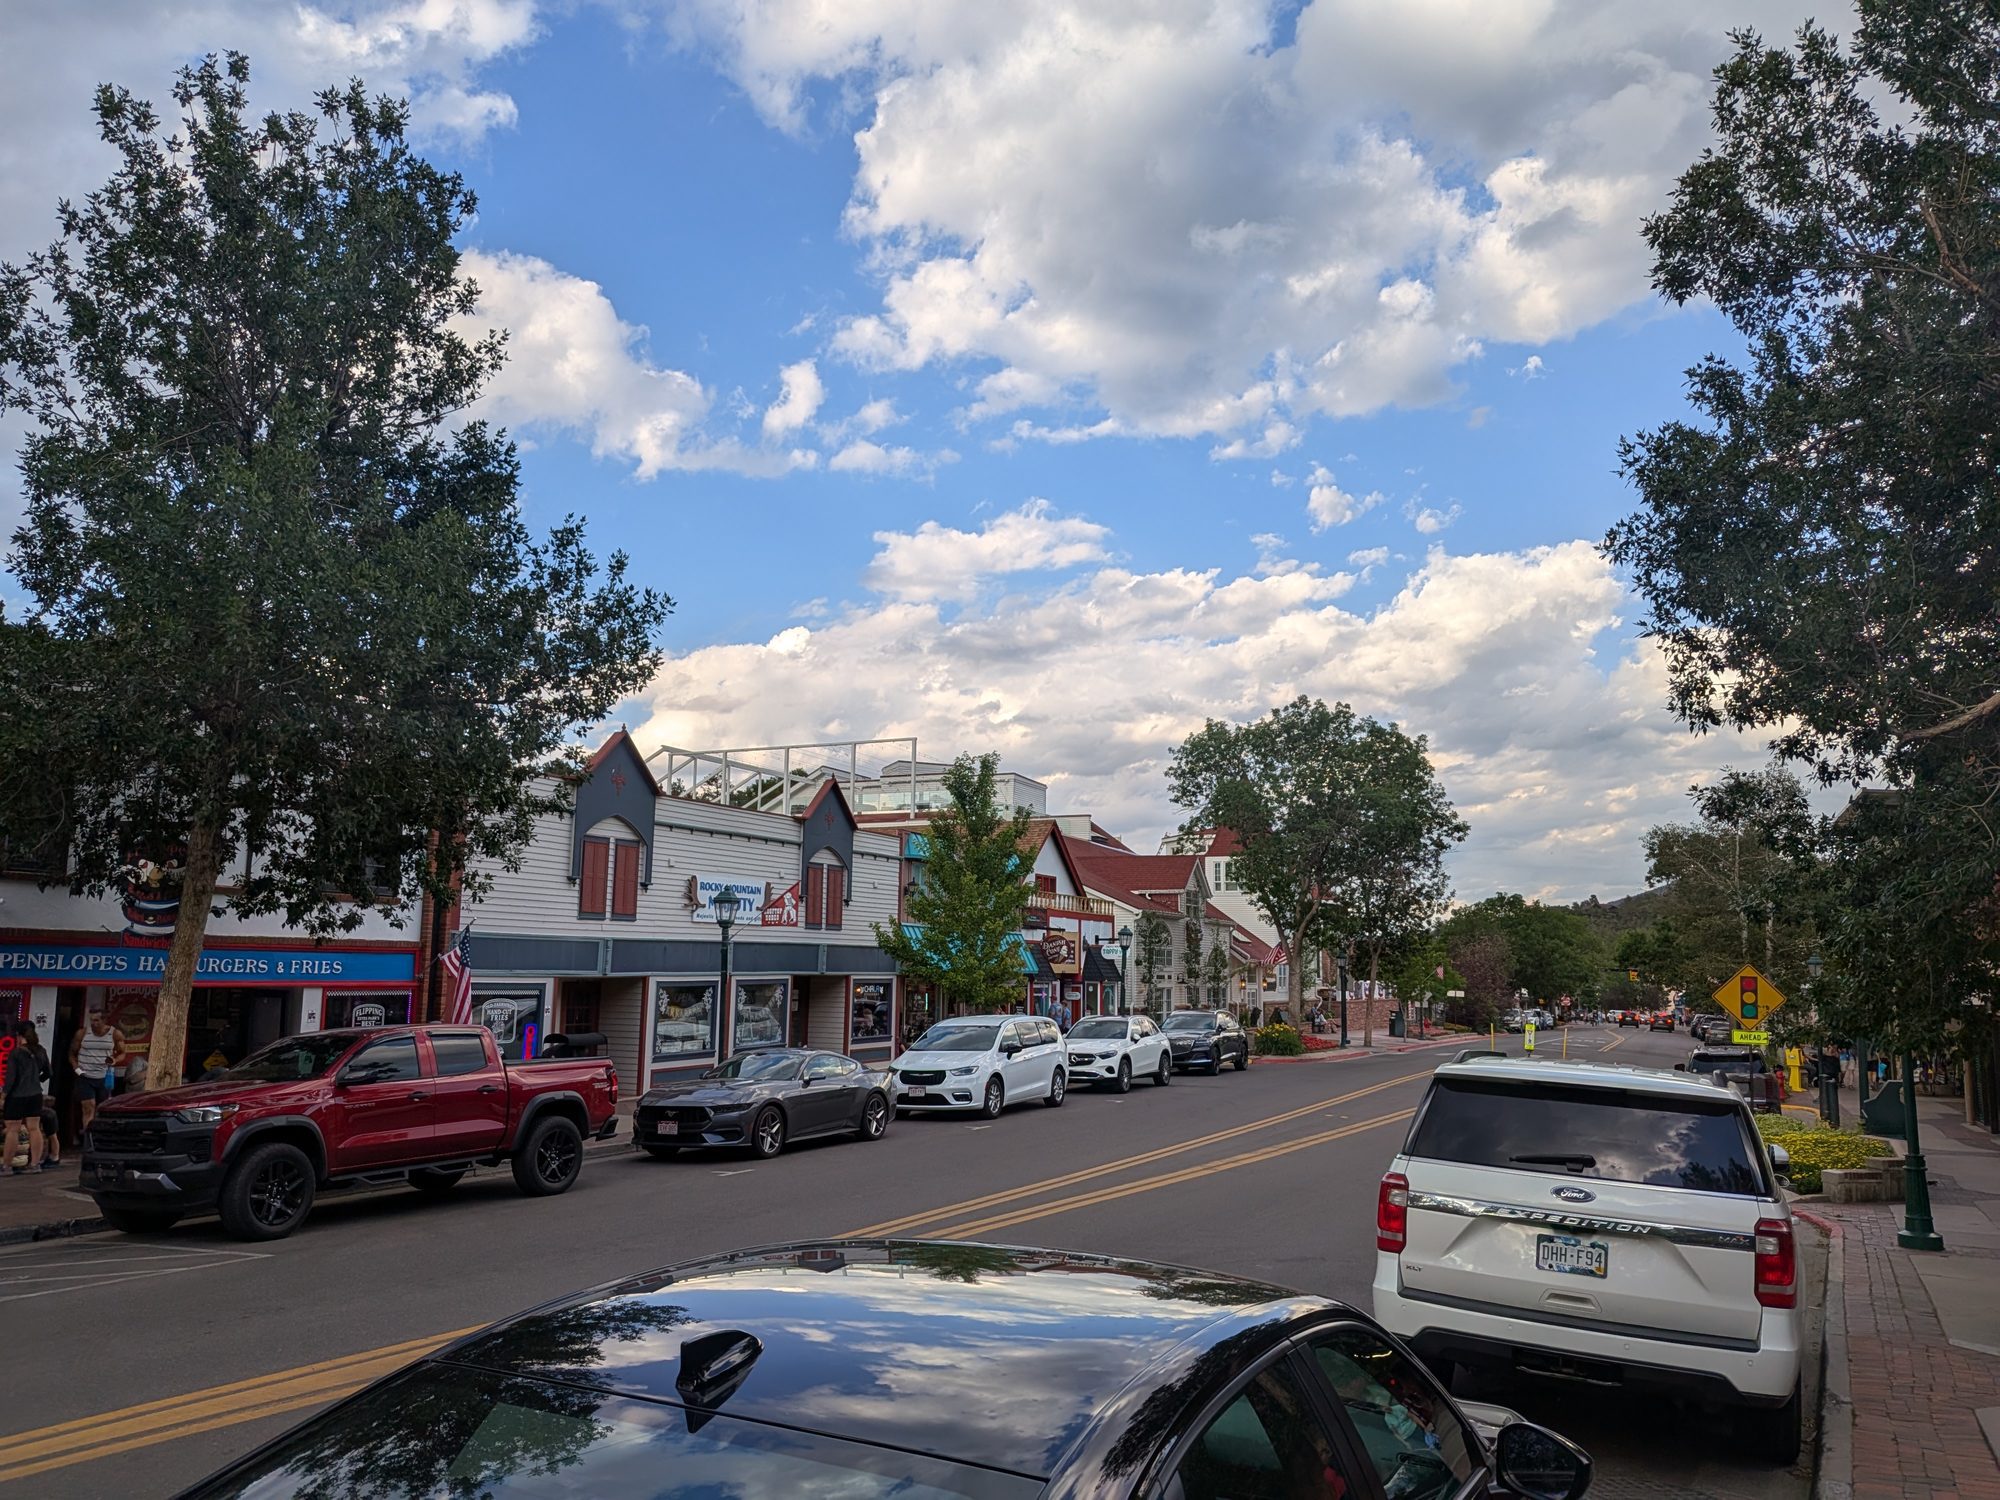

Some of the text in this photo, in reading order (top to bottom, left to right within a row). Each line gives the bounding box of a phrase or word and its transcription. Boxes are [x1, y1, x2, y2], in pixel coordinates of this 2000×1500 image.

[700, 882, 762, 895] ROCKY OUNTAIN
[0, 953, 343, 974] PENELOPE'S HAURGERS & FRIES
[355, 1007, 383, 1018] FLIPPING
[486, 1008, 512, 1016] HAND-CUT
[1739, 1033, 1762, 1041] AHEAD
[1560, 1187, 1585, 1200] Ford
[1496, 1207, 1651, 1235] EXPEDITION
[1719, 1235, 1750, 1247] MAX
[1405, 1264, 1423, 1273] XLT
